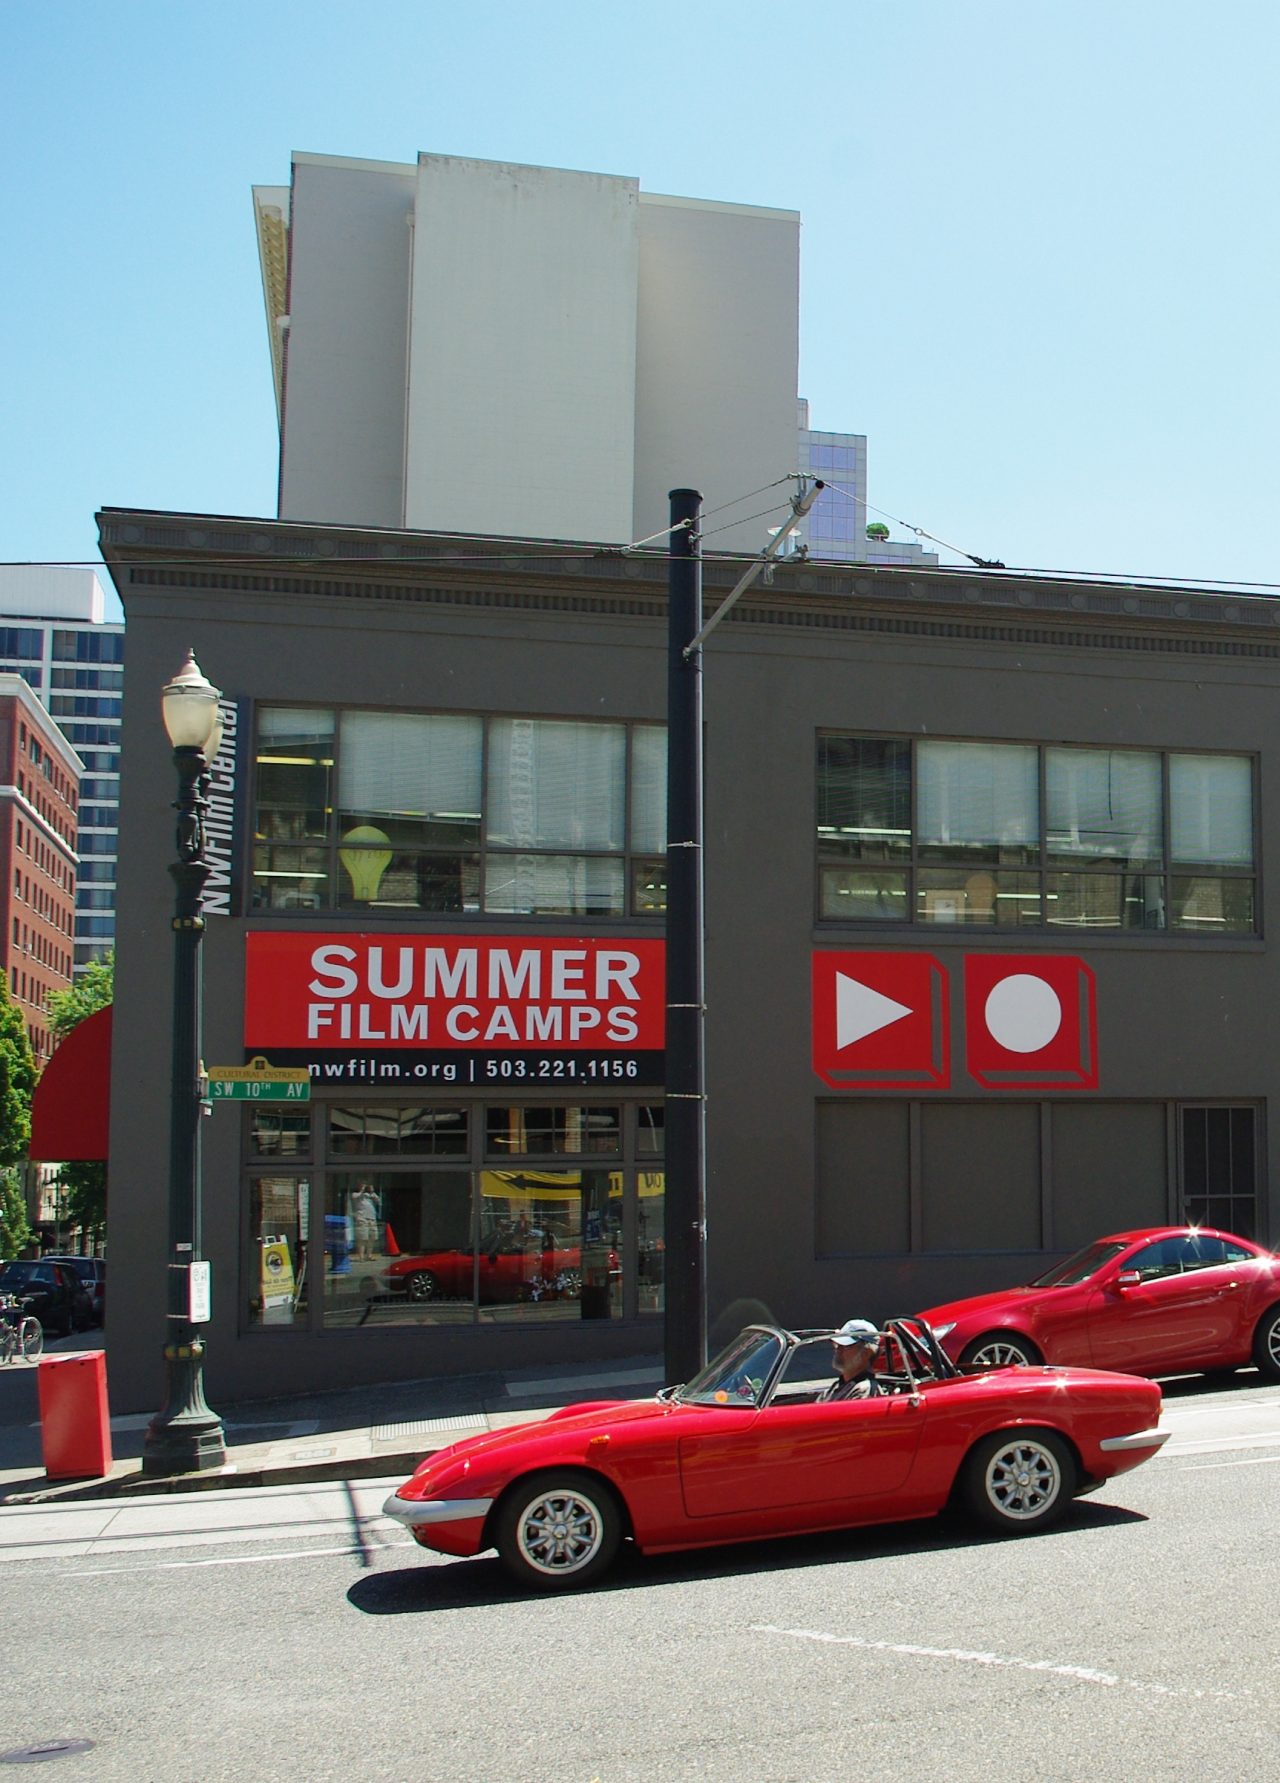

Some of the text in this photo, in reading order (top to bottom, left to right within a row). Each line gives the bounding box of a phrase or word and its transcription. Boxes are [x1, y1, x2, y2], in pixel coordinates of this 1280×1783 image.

[308, 944, 642, 1001] SUMMER
[307, 1003, 639, 1043] FILM CAMPS
[217, 1070, 302, 1079] CULTURAL DISTRICT
[308, 1059, 457, 1080] nwfilm.org
[486, 1060, 639, 1078] 503.221.1156
[214, 1082, 303, 1097] SW 10TH AV
